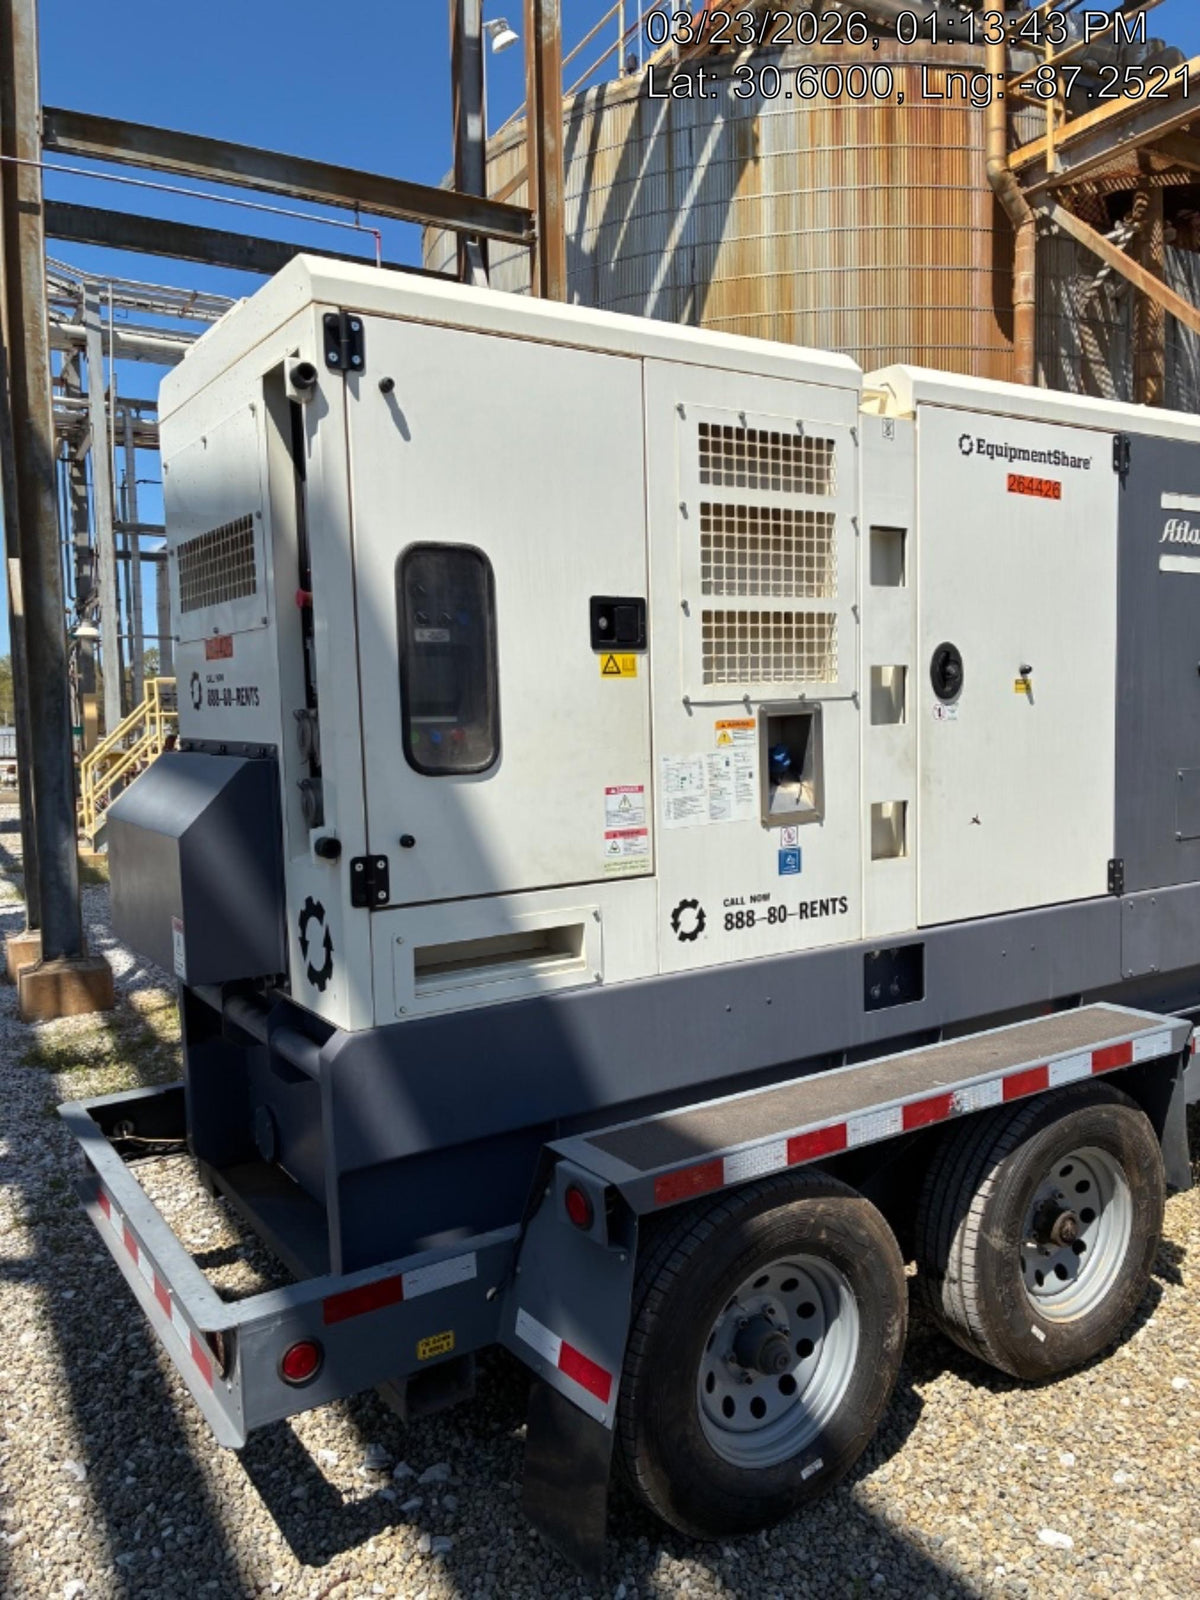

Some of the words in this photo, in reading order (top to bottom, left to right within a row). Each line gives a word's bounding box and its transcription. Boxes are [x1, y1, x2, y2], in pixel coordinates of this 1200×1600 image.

[975, 437, 1091, 470] EquipmentShare
[1007, 474, 1061, 500] 264426
[723, 897, 746, 907] CALL
[750, 893, 770, 904] NOW
[724, 896, 848, 931] 888-80-RENTS
